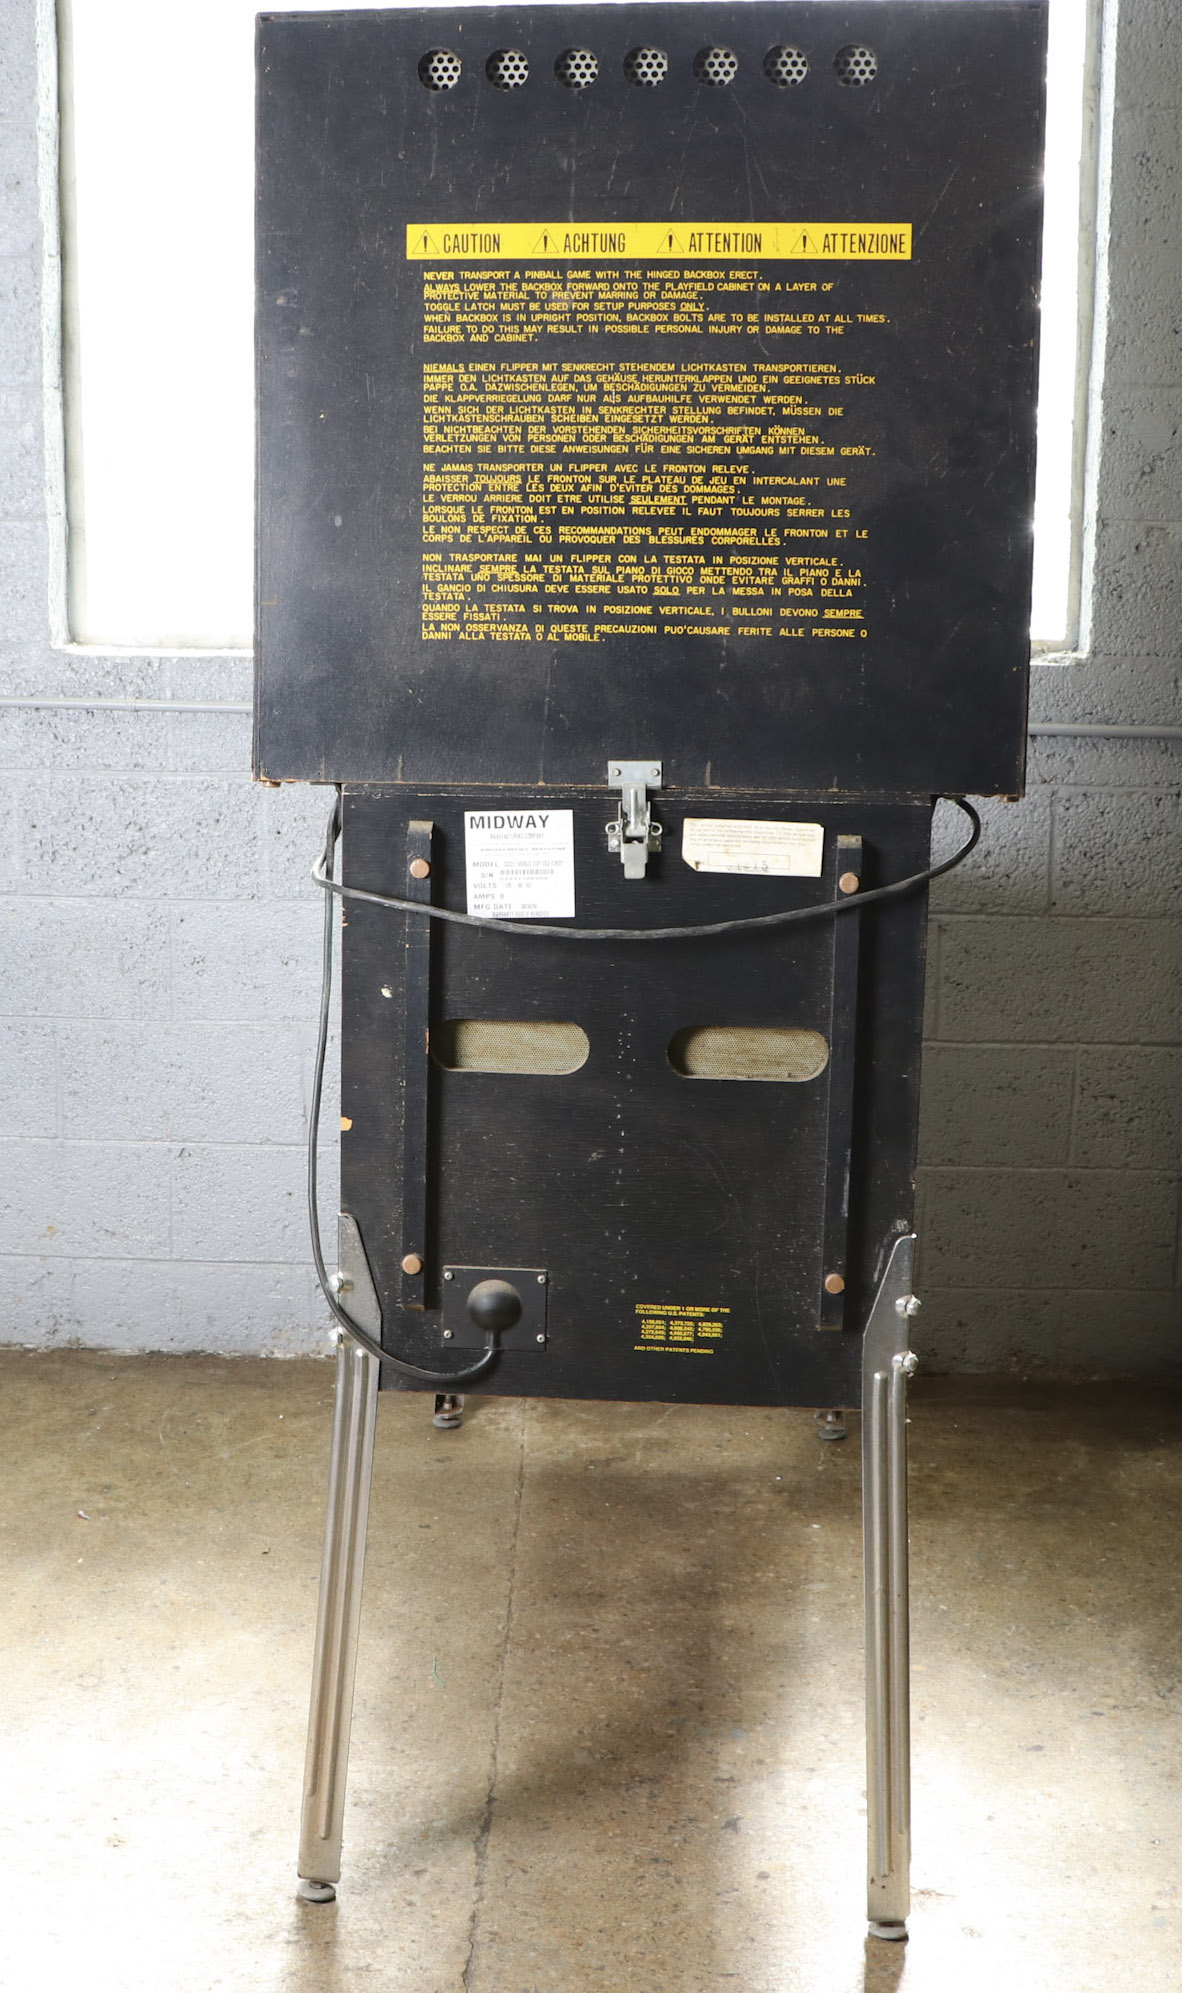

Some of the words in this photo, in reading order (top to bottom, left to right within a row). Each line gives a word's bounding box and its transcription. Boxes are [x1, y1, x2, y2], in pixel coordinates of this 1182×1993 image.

[443, 233, 501, 254] CAUTION
[564, 233, 626, 253] ACHTUNG
[689, 233, 762, 253] ATTENTION
[822, 233, 906, 254] ATTENZIONE
[423, 272, 455, 280] NEVER
[460, 272, 510, 280] TRANSPORT
[566, 271, 590, 279] GAME
[595, 271, 620, 279] WITH
[625, 271, 642, 279] THE
[647, 271, 681, 279] HINGED
[683, 271, 725, 279] BACKBOX
[425, 303, 460, 311] TOGGLE
[464, 303, 496, 311] LATCH
[500, 303, 525, 311] MUST
[529, 303, 540, 311] BE
[544, 303, 569, 311] USED
[572, 303, 590, 311] FOR
[424, 314, 451, 322] WHEN
[455, 314, 498, 322] BACKBOX
[502, 314, 512, 322] IS
[516, 314, 527, 322] IN
[530, 314, 570, 322] UPRIGHT
[626, 314, 668, 322] BACKBOX
[672, 314, 704, 322] BOLTS
[708, 314, 726, 322] ARE
[731, 314, 744, 322] TO
[747, 314, 758, 322] BE
[764, 314, 815, 323] INSTALLED
[818, 315, 830, 323] AT
[834, 315, 852, 323] ALL
[423, 364, 465, 372] NIEMALS
[619, 364, 676, 372] STEHENDEM
[681, 364, 747, 372] LICHTKASTEN
[444, 395, 542, 403] KLAPPVERRIEGELUNG
[547, 395, 571, 403] DARF
[576, 395, 597, 403] NUR
[603, 395, 622, 403] ALS
[698, 396, 756, 404] VERWENDET
[424, 406, 452, 414] WENN
[457, 406, 480, 414] SICH
[485, 406, 505, 414] DER
[509, 406, 576, 414] LICHTKASTEN
[672, 407, 722, 415] STELLUNG
[782, 406, 822, 415] MÜSSEN
[828, 408, 842, 416] DIE
[423, 464, 435, 472] NE
[442, 464, 474, 472] JAMAIS
[478, 464, 544, 472] TRANSPORTER
[549, 464, 563, 472] UN
[662, 465, 707, 473] FRONTON
[440, 495, 478, 503] VERROU
[484, 495, 522, 503] ARRIERE
[528, 495, 551, 503] DOIT
[556, 495, 582, 503] ETRE
[630, 496, 686, 505] SEULEMENT
[690, 496, 734, 504] PENDANT
[742, 496, 754, 504] LE
[422, 506, 465, 514] LORSQUE
[489, 507, 534, 515] FRONTON
[538, 507, 556, 515] EST
[560, 507, 575, 515] EN
[580, 507, 626, 515] POSITION
[631, 507, 676, 515] RELEVEE
[682, 508, 691, 516] IL
[697, 508, 722, 516] FAUT
[731, 508, 781, 517] TOUJOURS
[786, 509, 825, 517] SERRER
[830, 509, 851, 518] LES
[421, 554, 443, 562] NON
[450, 554, 517, 562] TRASPORTARE
[570, 555, 612, 563] FLIPPER
[617, 555, 638, 563] CON
[664, 556, 706, 564] TESTATA
[712, 556, 724, 564] IN
[728, 556, 779, 565] POSIZIONE
[437, 585, 472, 593] GANCIO
[476, 585, 486, 593] DI
[490, 585, 538, 593] CHIUSURA
[544, 586, 569, 594] DEVE
[574, 586, 611, 594] ESSERE
[617, 586, 649, 594] USATO
[653, 586, 680, 595] SOLO
[685, 587, 706, 595] PER
[711, 587, 725, 595] LA
[731, 587, 765, 596] MESSA
[770, 588, 782, 596] IN
[787, 588, 813, 596] POSA
[820, 588, 852, 597] DELLA
[464, 605, 479, 613] LA
[485, 605, 526, 613] TESTATA
[548, 606, 579, 614] TROVA
[586, 606, 597, 614] IN
[603, 606, 653, 615] POSIZIONE
[721, 607, 725, 616] I
[731, 608, 773, 616] BULLONI
[779, 608, 819, 617] DEVONO
[824, 609, 862, 618] SEMPRE
[470, 815, 549, 829] MIDWAY
